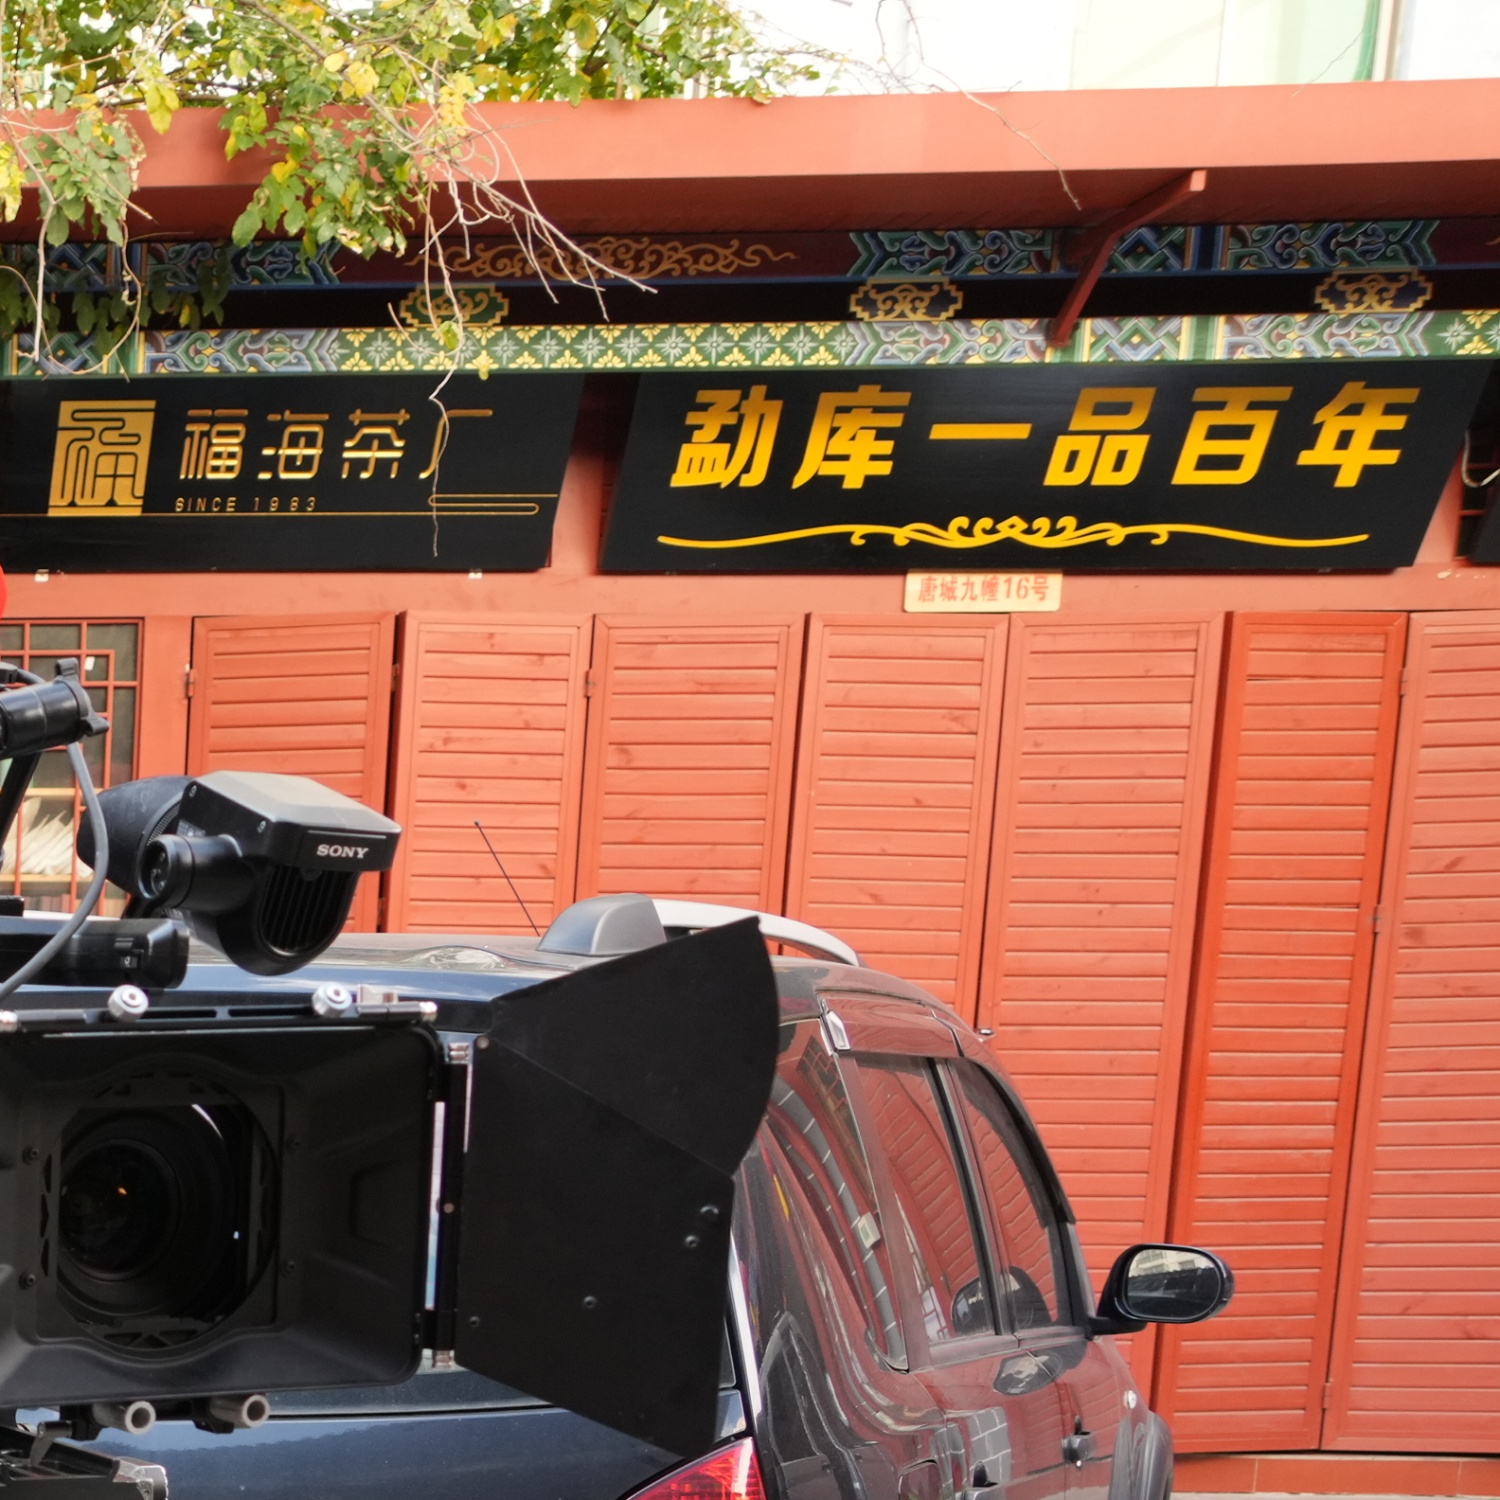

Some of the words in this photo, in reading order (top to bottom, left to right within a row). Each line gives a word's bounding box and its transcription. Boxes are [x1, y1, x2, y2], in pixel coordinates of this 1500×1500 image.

[180, 408, 493, 480] 福海茶厂
[670, 381, 1420, 489] 勐库一品百年
[175, 497, 237, 512] SINCE
[317, 844, 369, 859] SONY
